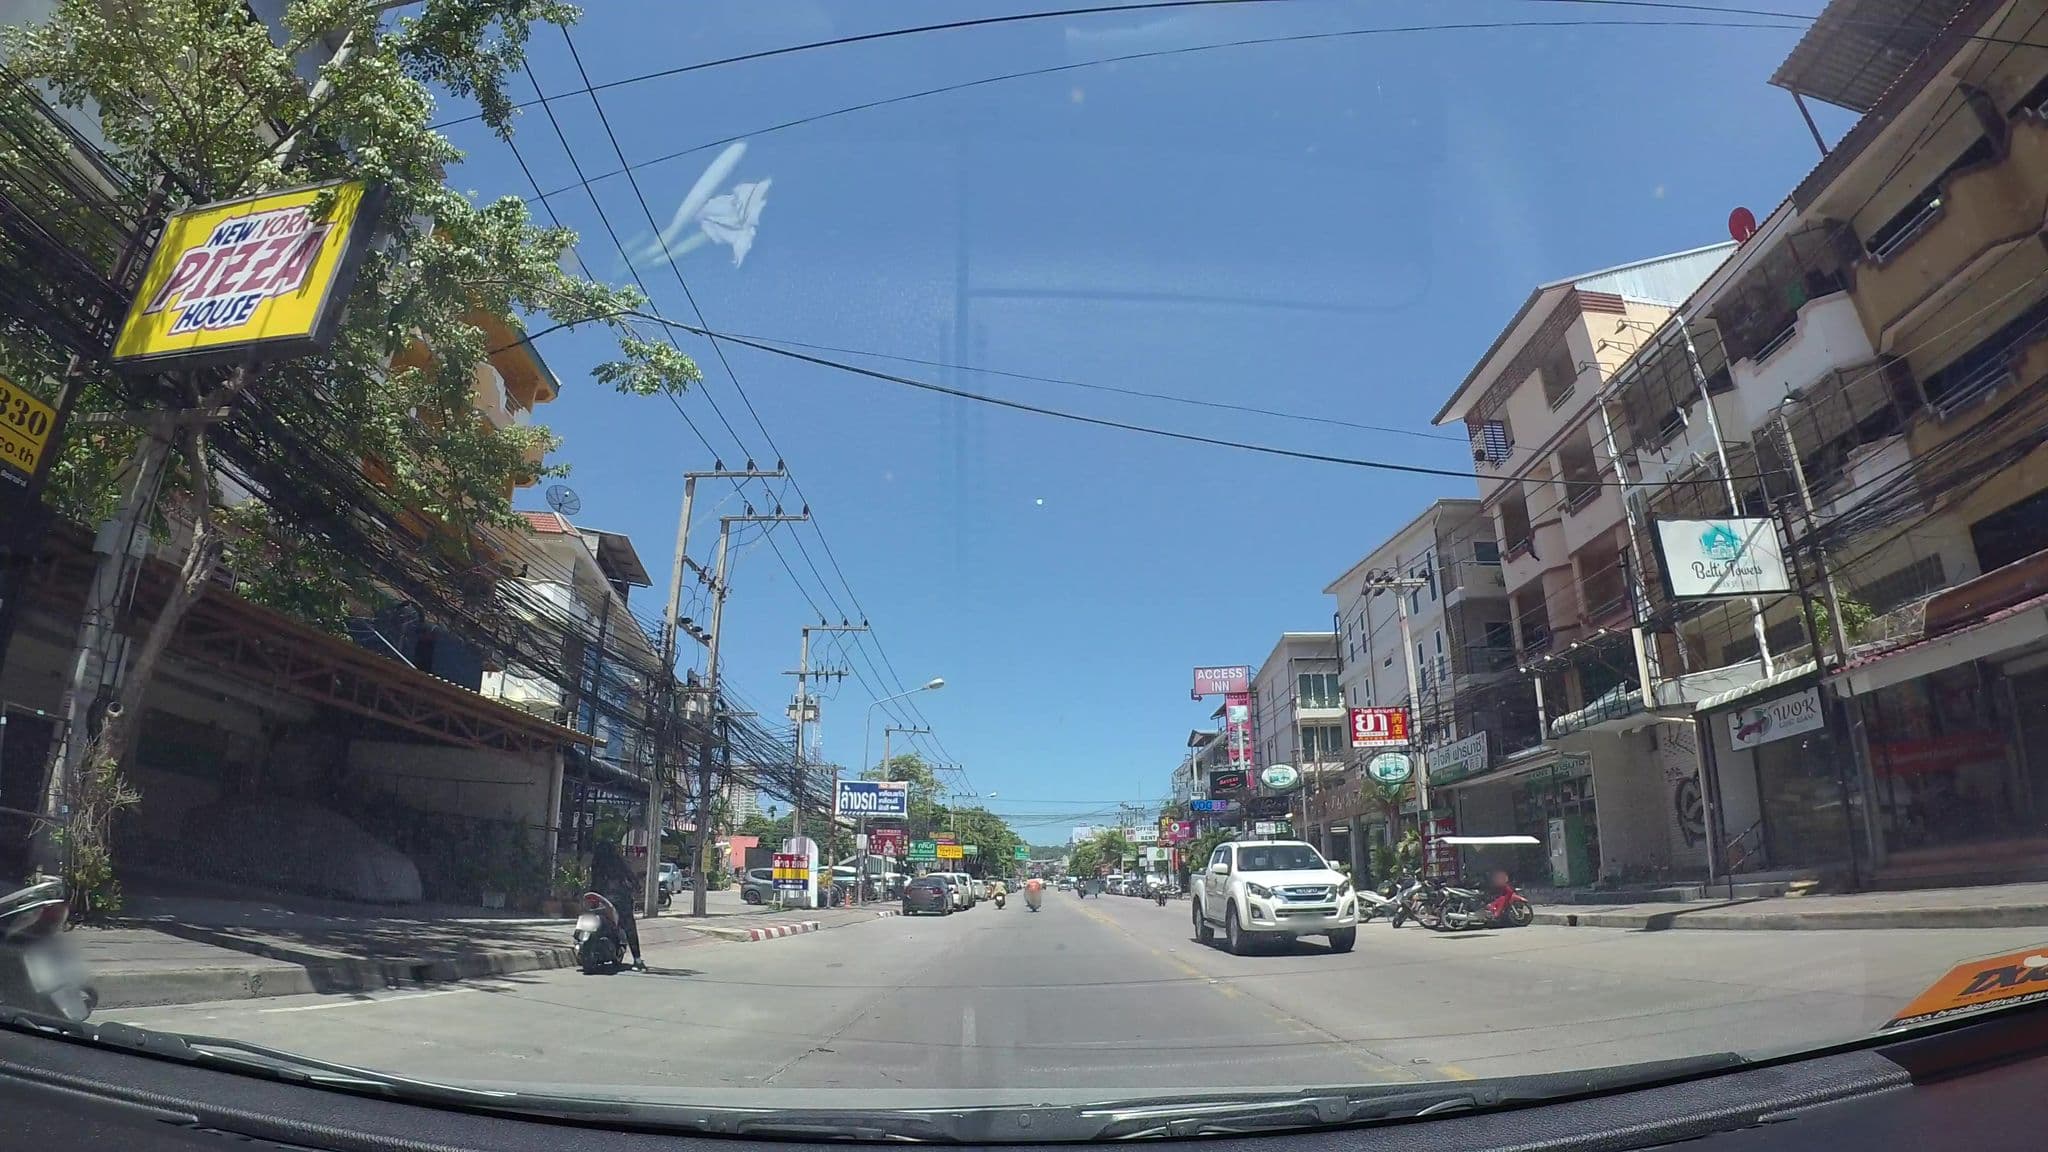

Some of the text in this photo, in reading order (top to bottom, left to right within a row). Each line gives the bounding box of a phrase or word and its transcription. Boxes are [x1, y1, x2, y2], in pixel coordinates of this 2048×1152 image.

[207, 219, 261, 248] NEW
[154, 229, 325, 307] PIZZA
[175, 292, 264, 330] HOUSE
[1724, 559, 1763, 578] Towers
[1197, 668, 1243, 680] ACCESS
[1211, 681, 1230, 692] INN
[1773, 696, 1817, 721] WOK
[1355, 713, 1388, 732] ยา
[841, 784, 877, 811] ล้างรถ
